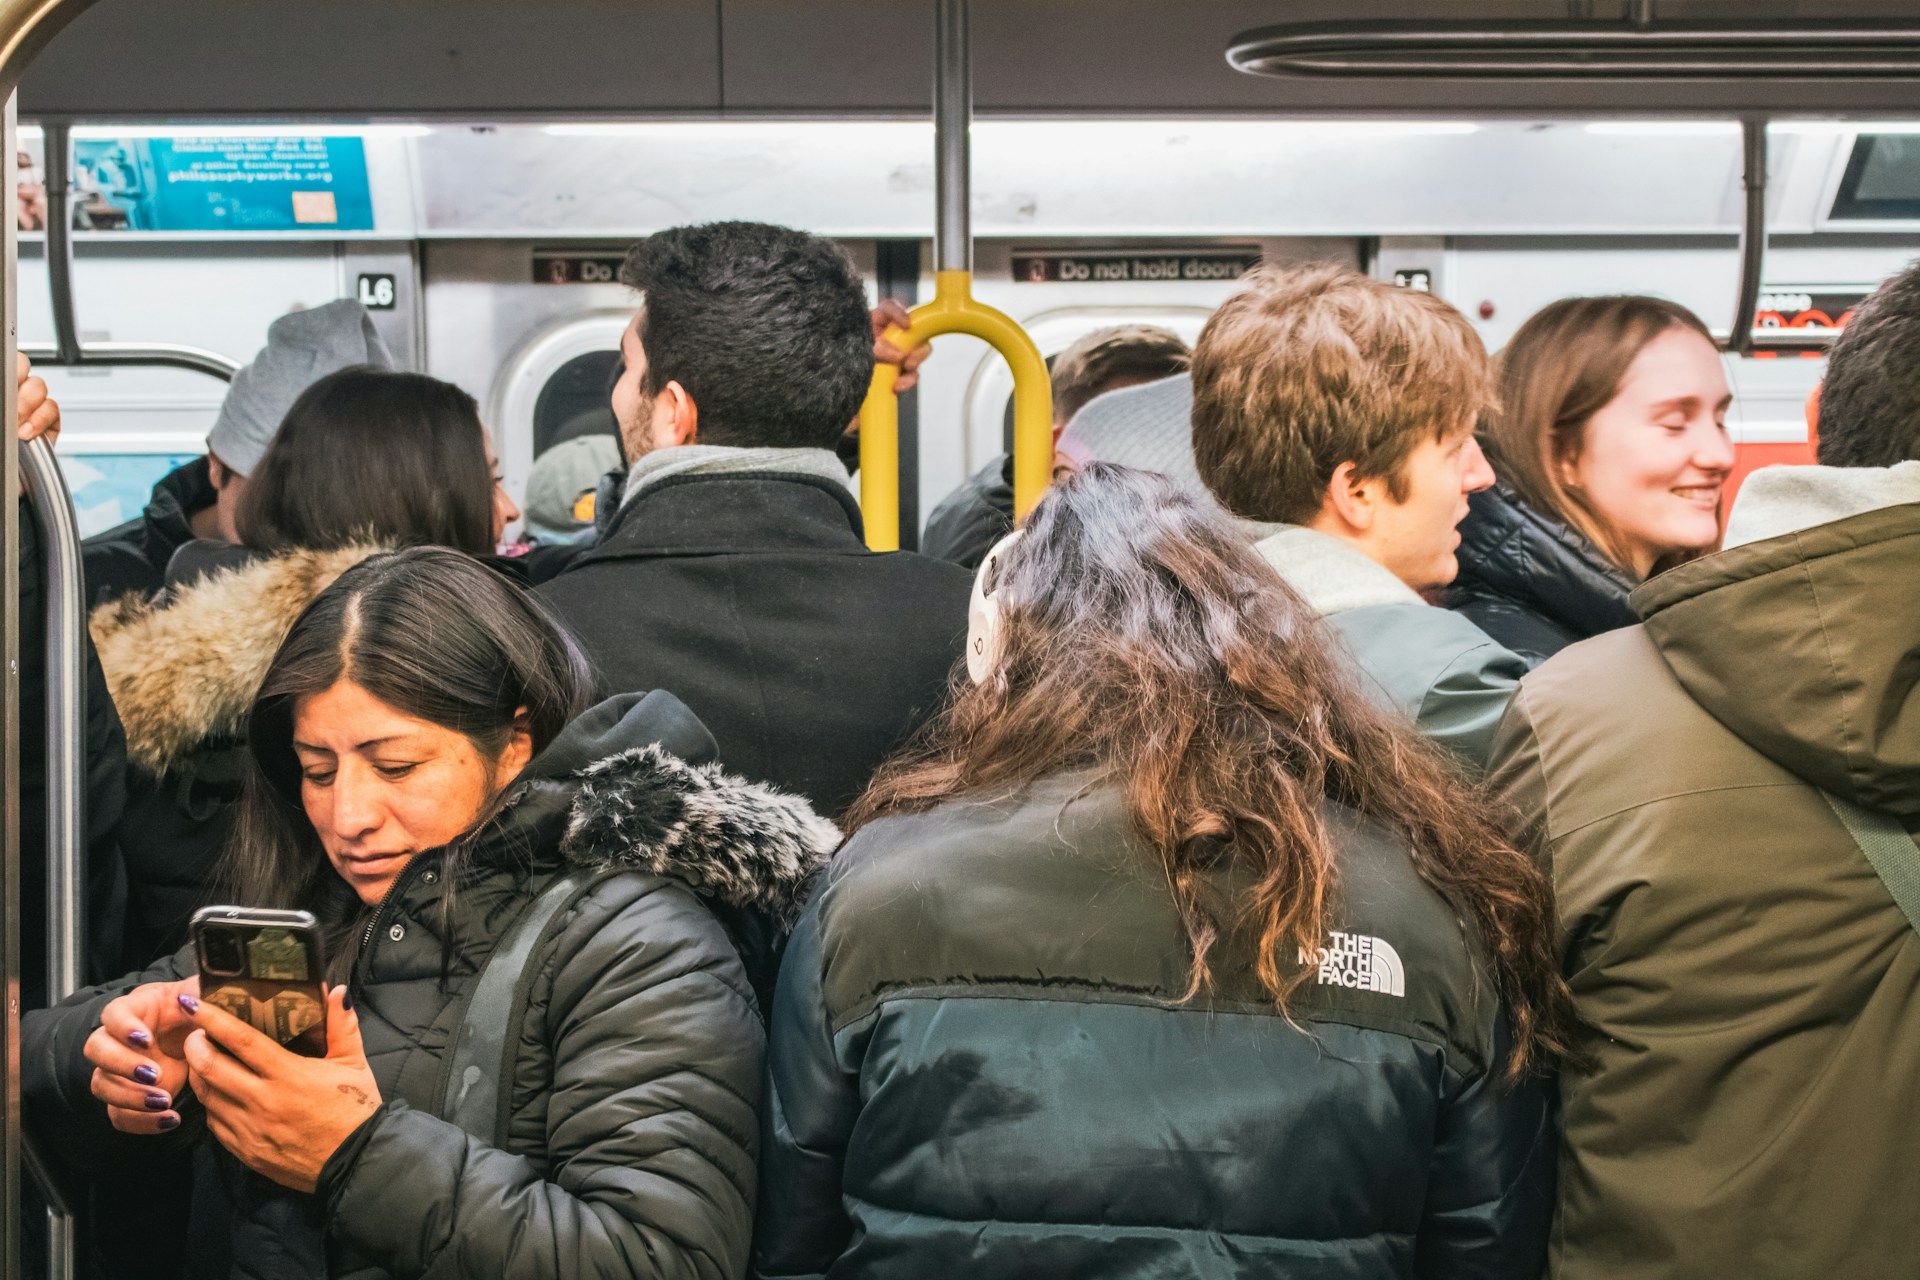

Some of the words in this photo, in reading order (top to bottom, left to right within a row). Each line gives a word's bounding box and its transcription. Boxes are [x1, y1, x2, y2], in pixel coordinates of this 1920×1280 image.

[168, 171, 333, 183] philosophyworks.org
[581, 261, 612, 281] Do
[1059, 260, 1090, 281] Do
[1094, 260, 1128, 280] not
[1133, 260, 1180, 280] hold
[360, 277, 394, 306] L6
[1329, 931, 1372, 954] THE
[1298, 946, 1372, 973] NORTH
[1317, 966, 1372, 991] FACE
